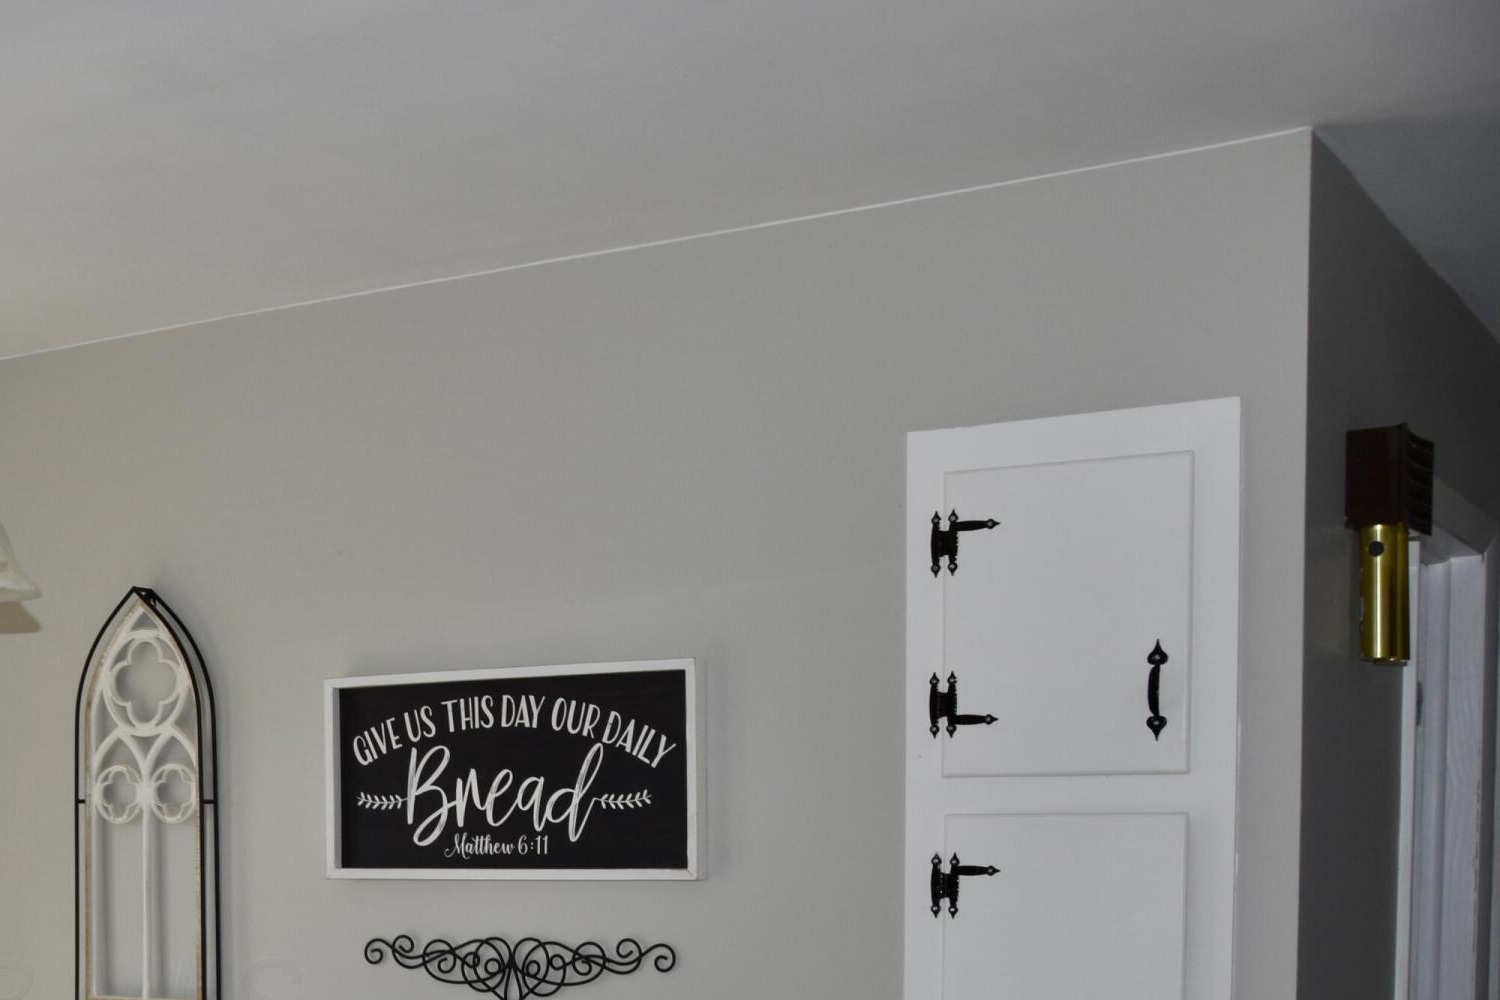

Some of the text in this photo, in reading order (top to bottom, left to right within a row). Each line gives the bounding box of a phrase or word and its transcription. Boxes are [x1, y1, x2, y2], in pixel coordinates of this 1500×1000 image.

[352, 694, 677, 769] GIVE US THIS DAY OUR DAILY
[407, 743, 604, 847] Bread
[443, 832, 549, 860] Matthew 6:11
